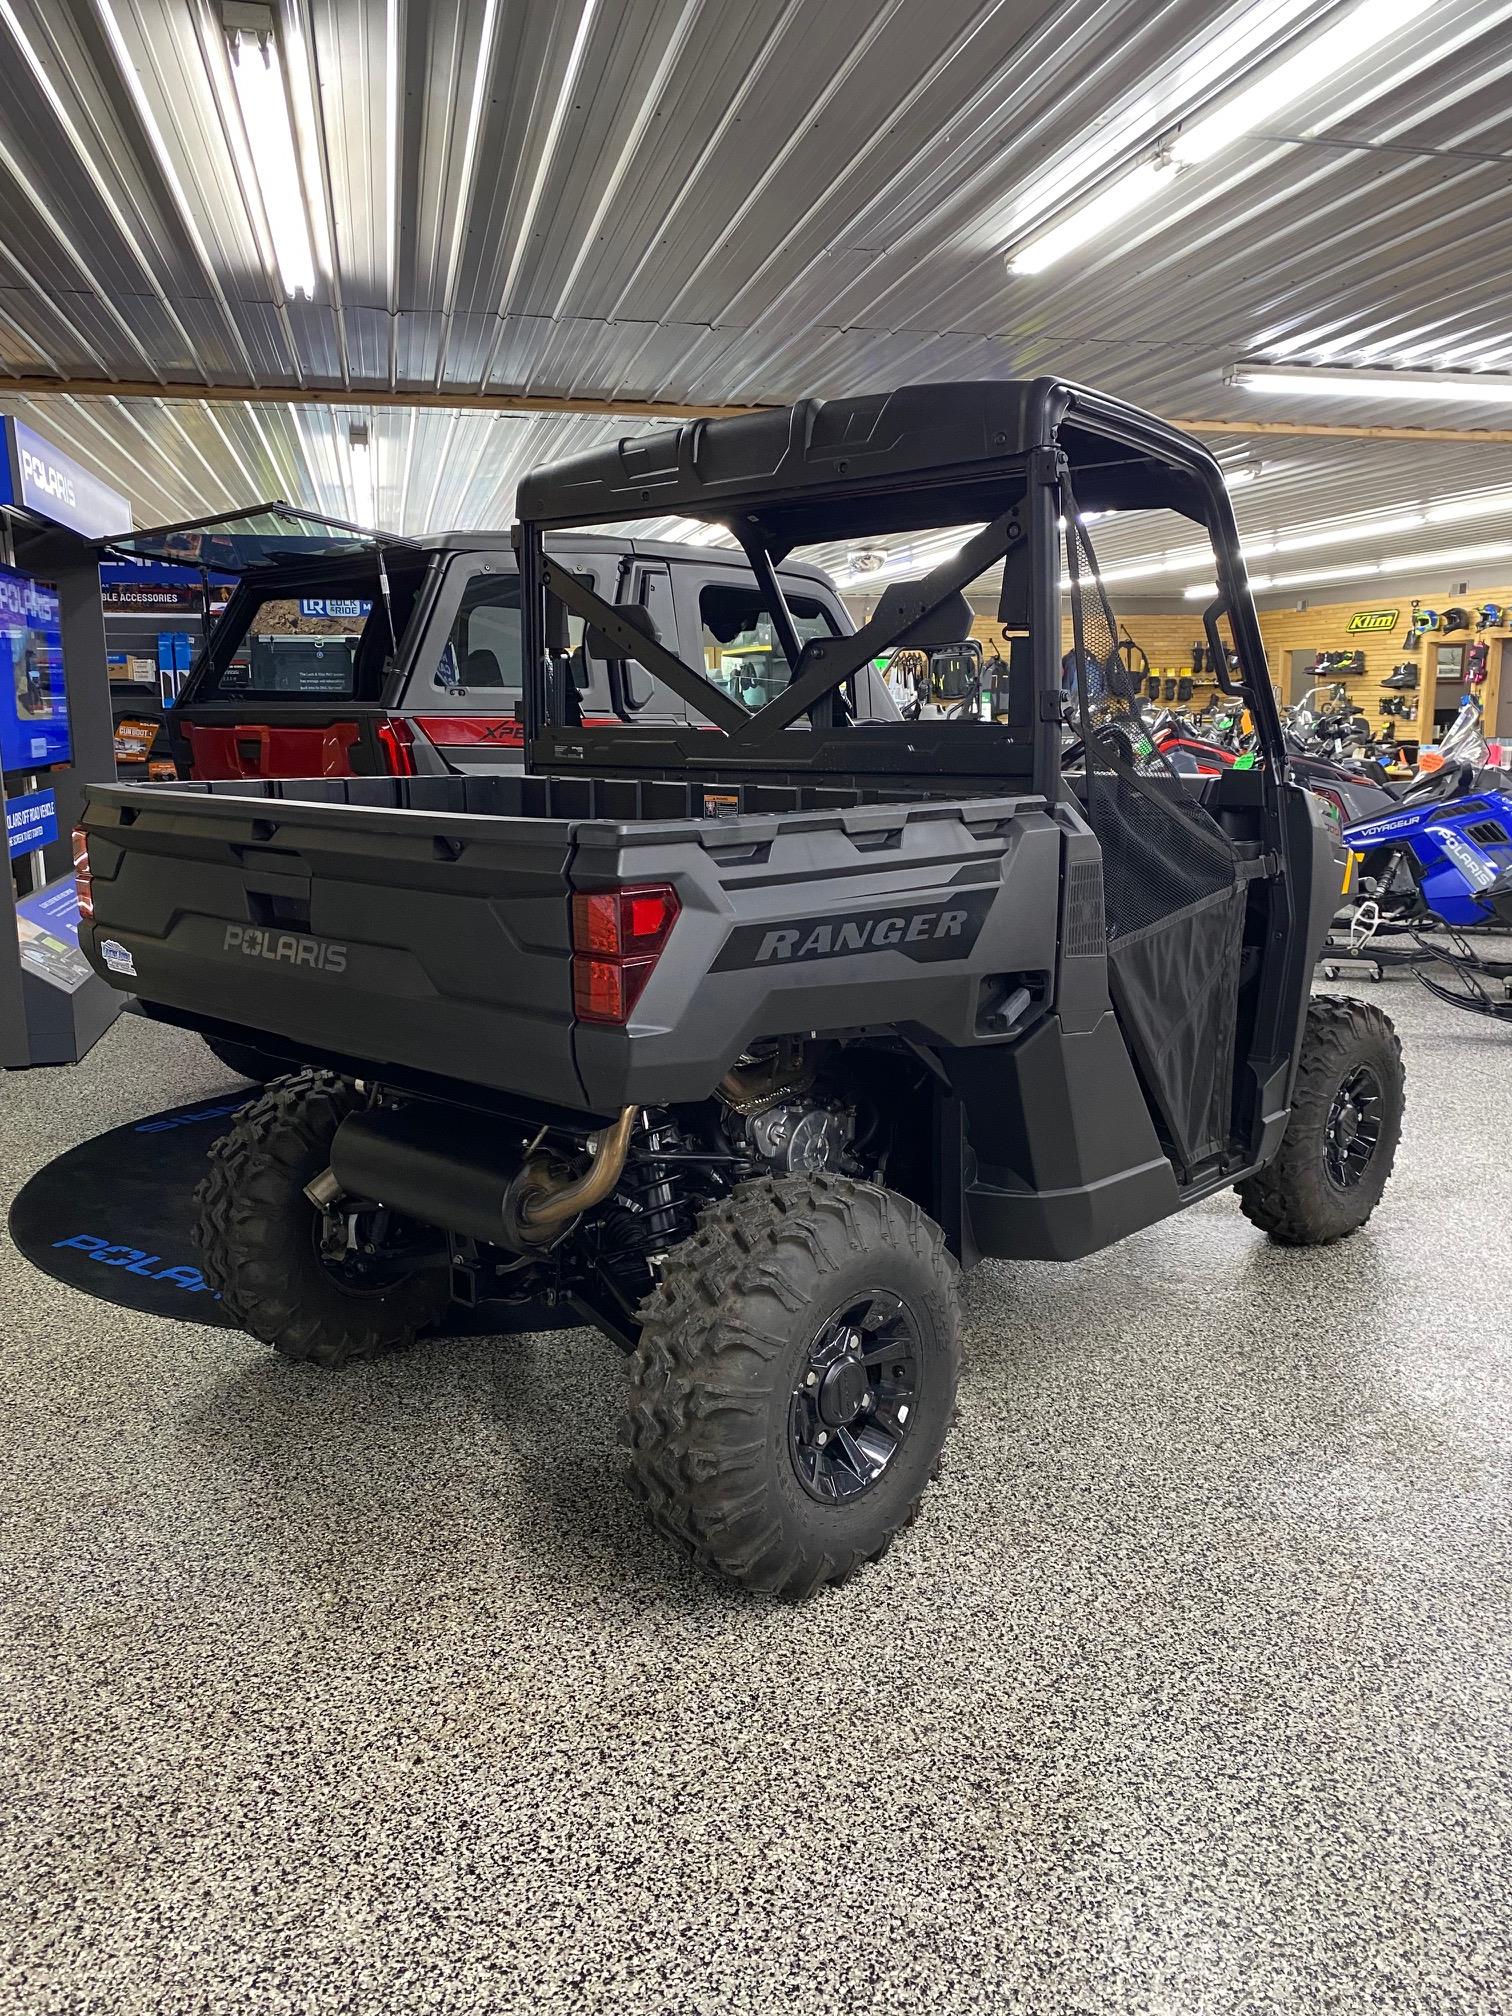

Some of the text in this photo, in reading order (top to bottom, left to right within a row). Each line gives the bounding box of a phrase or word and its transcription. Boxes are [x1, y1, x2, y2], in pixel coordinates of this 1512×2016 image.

[22, 449, 76, 508] POLARIS
[120, 593, 178, 603] ACCESSORIES
[1349, 615, 1393, 629] Klim
[1361, 816, 1420, 836] VOYAGEUR
[1438, 830, 1490, 886] POLARIS
[223, 925, 347, 973] POLARIS
[754, 910, 968, 962] RANGER
